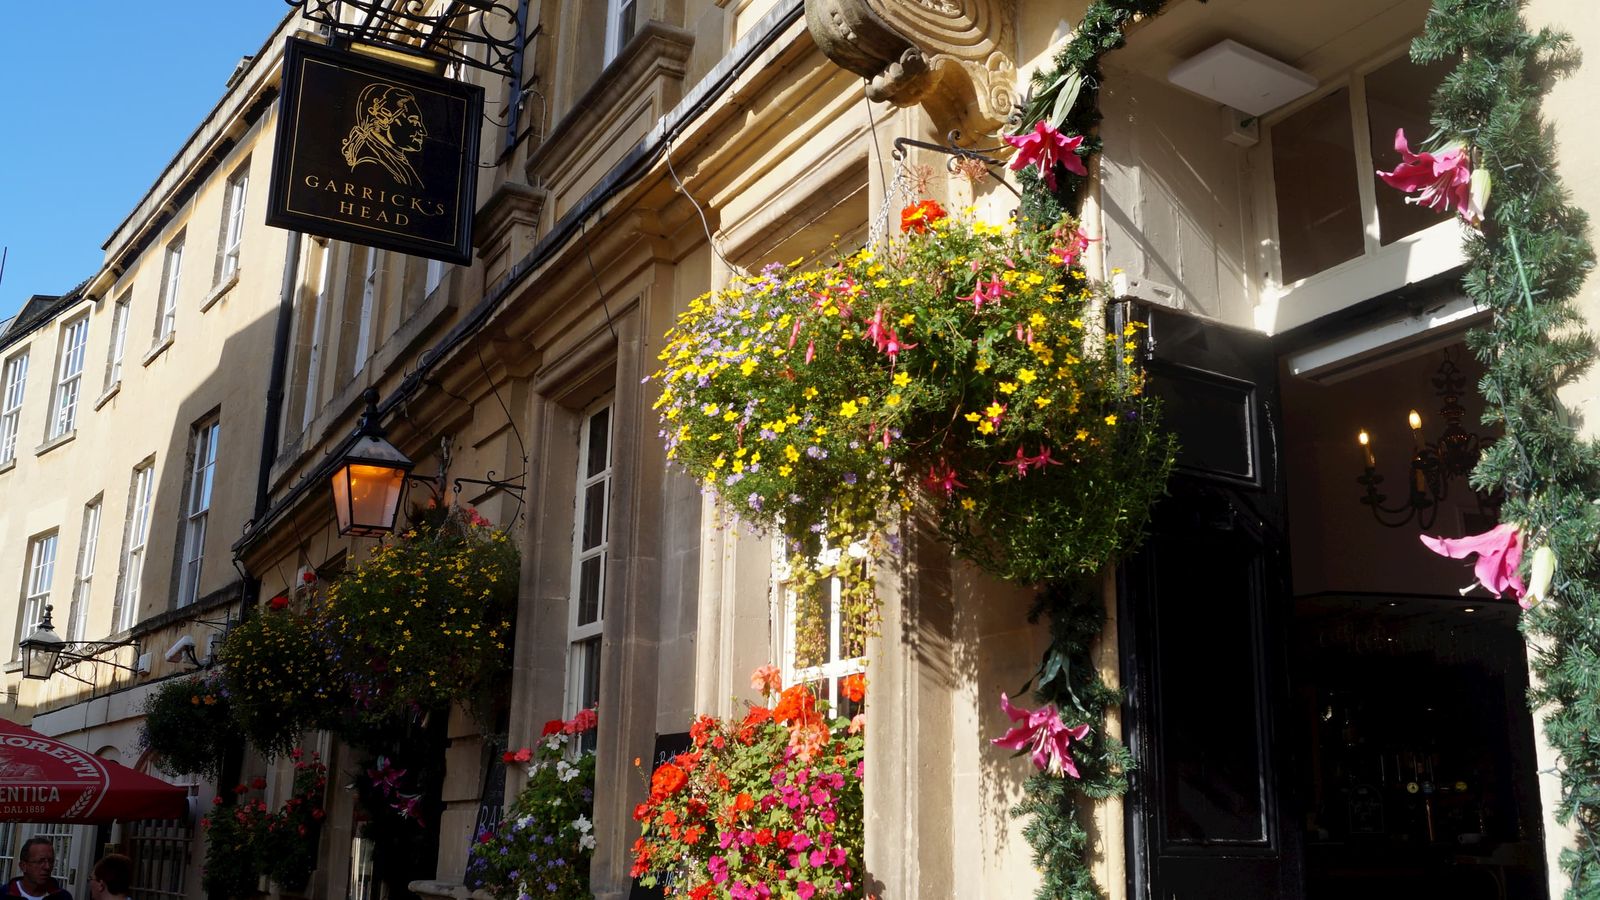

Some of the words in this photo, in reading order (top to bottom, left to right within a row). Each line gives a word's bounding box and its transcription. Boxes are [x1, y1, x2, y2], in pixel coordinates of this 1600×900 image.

[305, 175, 444, 216] GARRICK'S
[339, 201, 409, 226] HEAD
[0, 736, 100, 778] ORETTI
[3, 806, 23, 814] DAL
